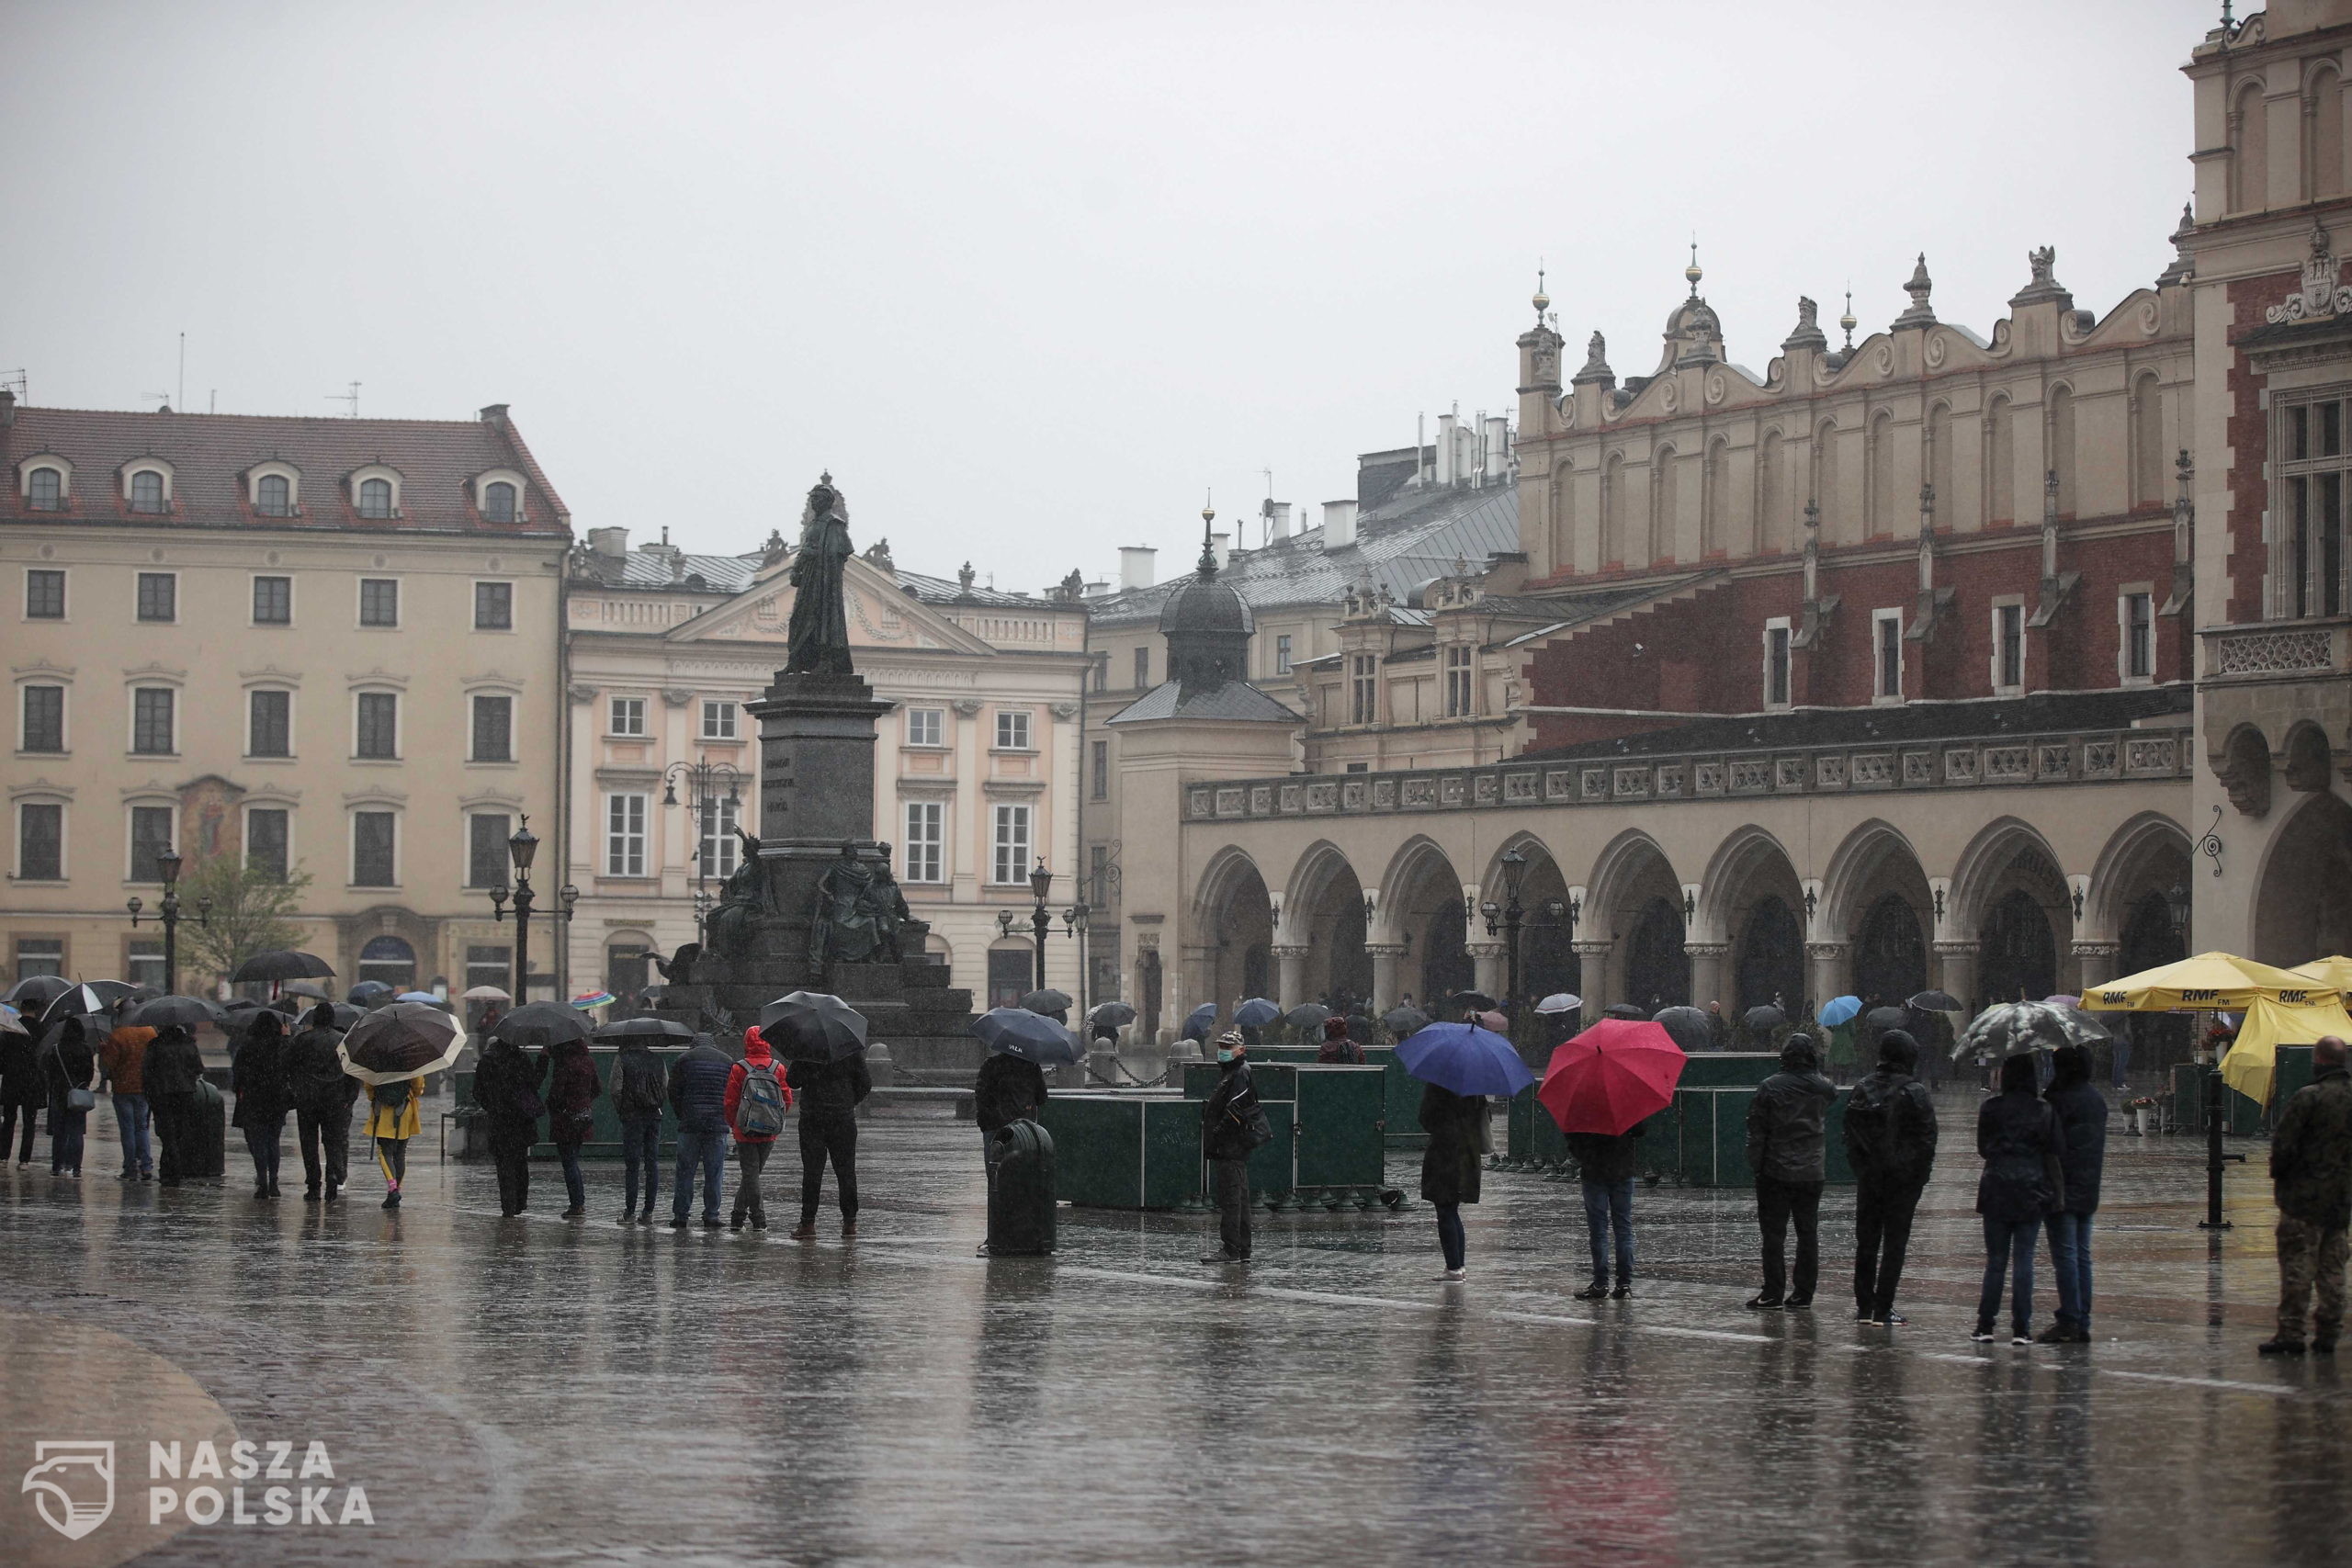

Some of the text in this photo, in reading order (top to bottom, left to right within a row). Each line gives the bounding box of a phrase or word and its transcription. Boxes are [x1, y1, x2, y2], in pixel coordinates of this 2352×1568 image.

[2103, 991, 2128, 1004] RMF
[2182, 989, 2220, 1001] RMF
[2279, 990, 2308, 1002] RMF
